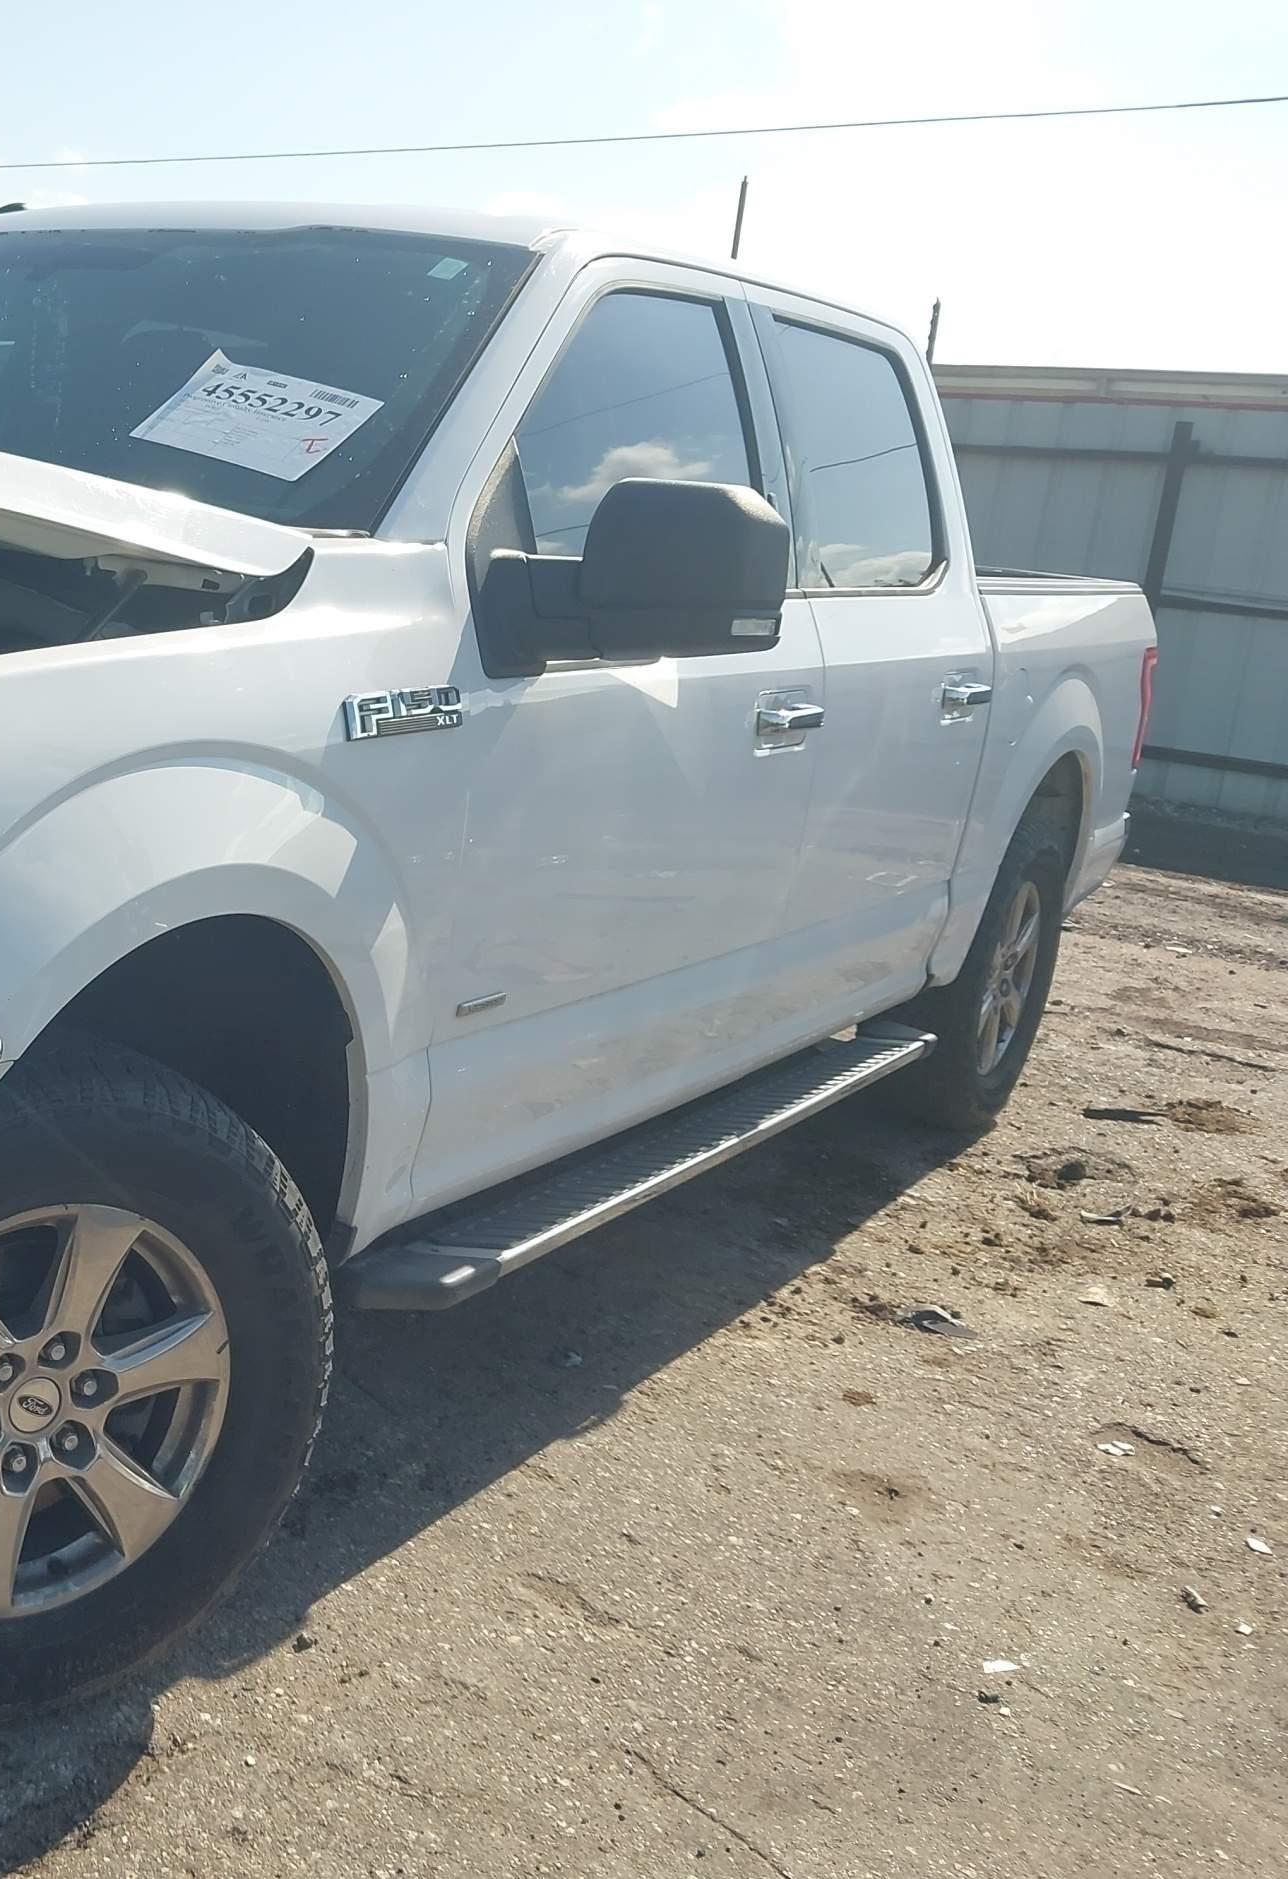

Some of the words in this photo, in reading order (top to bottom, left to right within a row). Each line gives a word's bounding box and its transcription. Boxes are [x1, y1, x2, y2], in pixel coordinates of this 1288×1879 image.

[201, 382, 343, 427] 45552297
[435, 714, 459, 727] XLT
[21, 1396, 50, 1415] Ford
